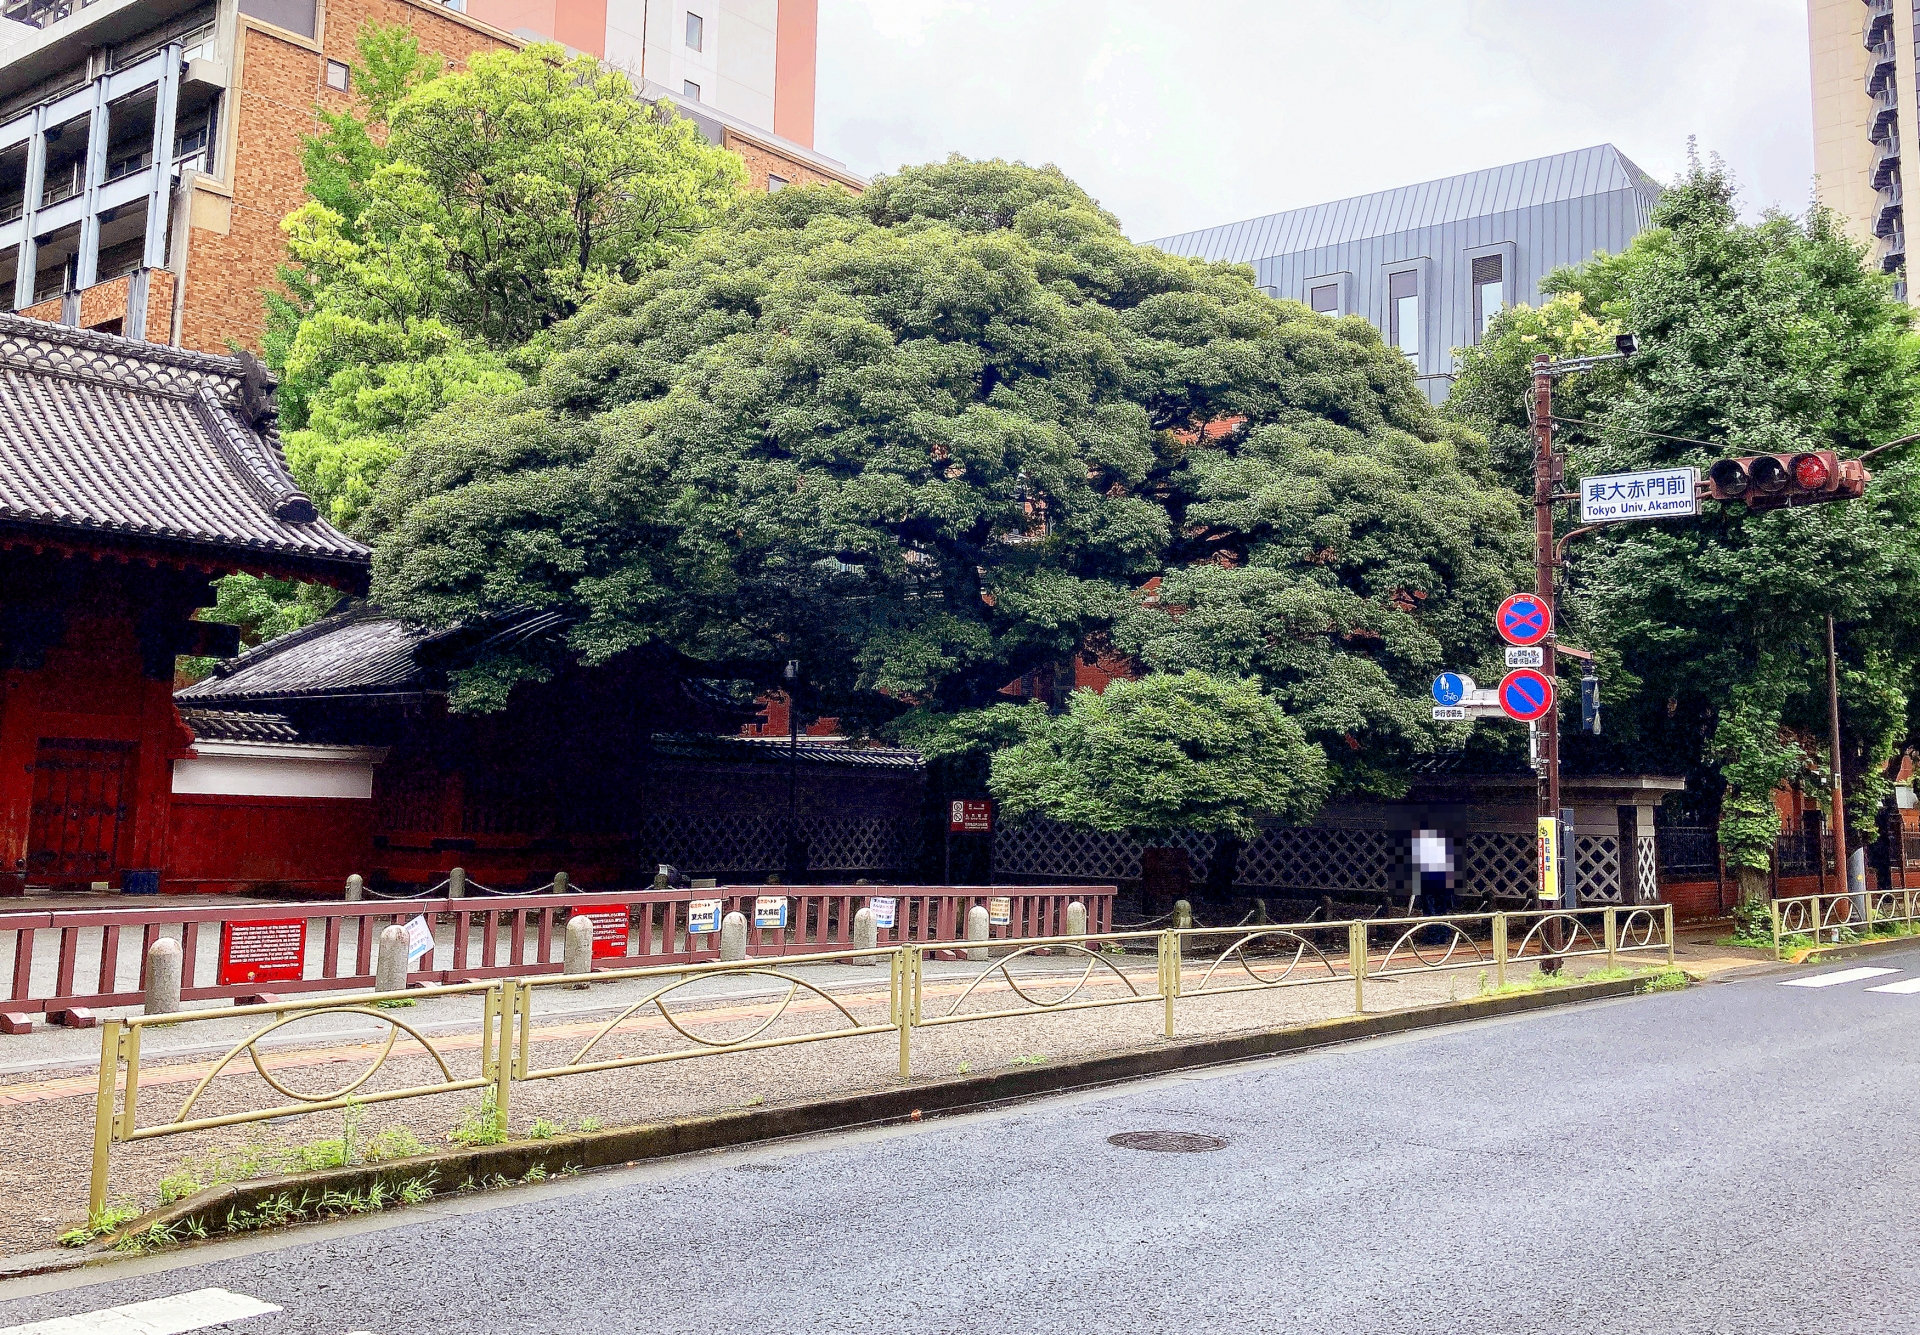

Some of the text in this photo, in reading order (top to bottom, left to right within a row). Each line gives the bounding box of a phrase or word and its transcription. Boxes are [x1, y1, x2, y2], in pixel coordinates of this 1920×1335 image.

[1588, 475, 1686, 503] 東大赤門前
[1586, 499, 1692, 516] Tokyo Univ. Akamon
